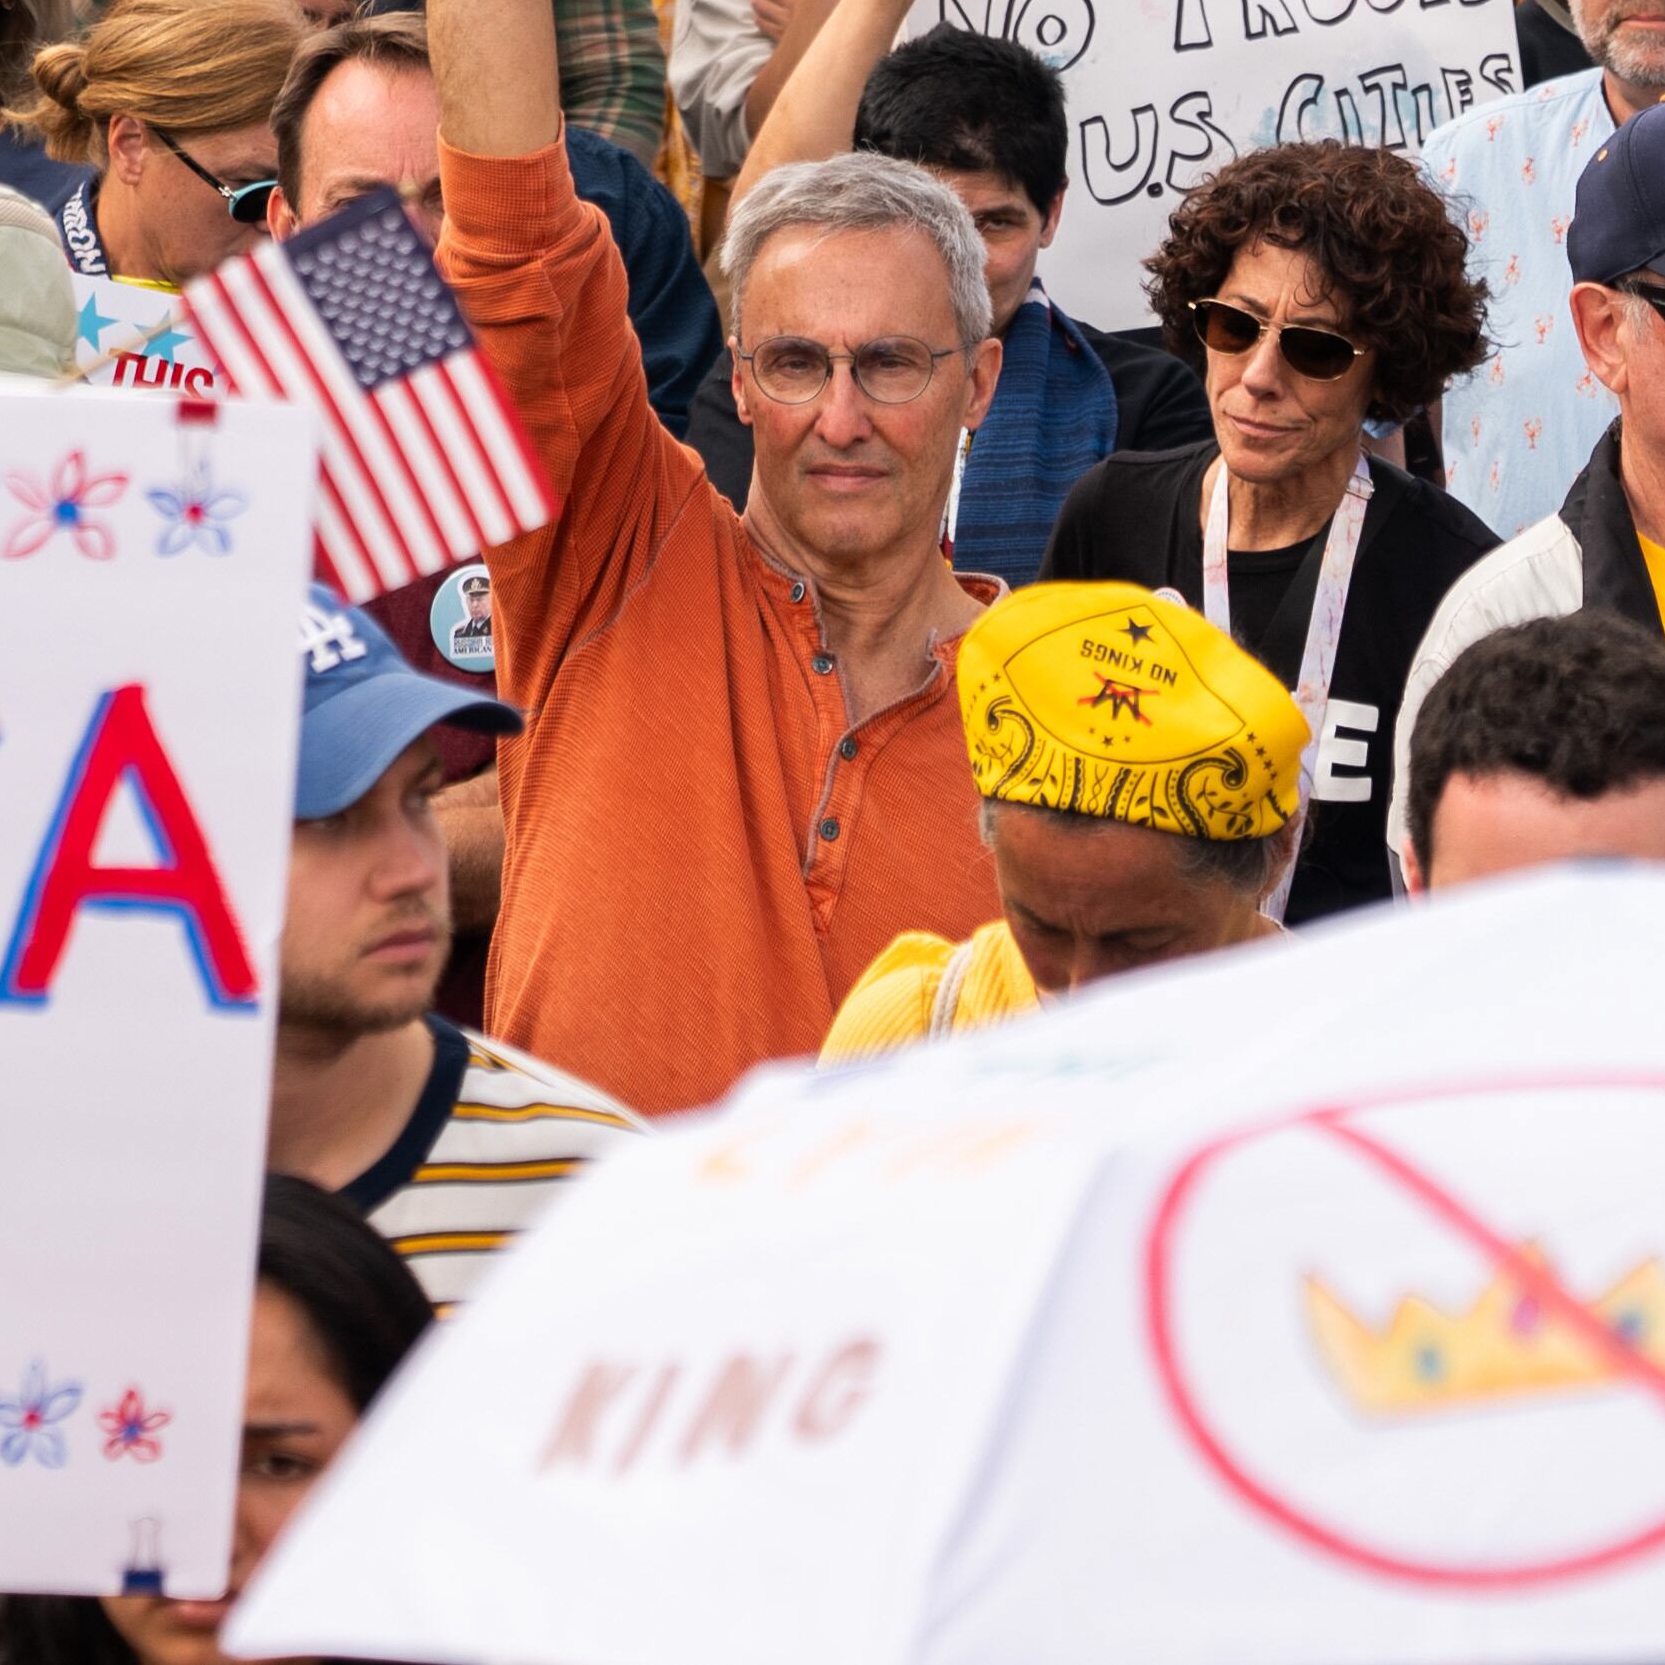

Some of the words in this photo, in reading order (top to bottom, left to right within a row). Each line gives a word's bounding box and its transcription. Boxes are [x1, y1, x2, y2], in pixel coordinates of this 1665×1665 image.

[1275, 52, 1516, 152] CITIES
[1078, 637, 1143, 672] KINGS
[1150, 667, 1178, 688] NO
[536, 1333, 887, 1482] KING
